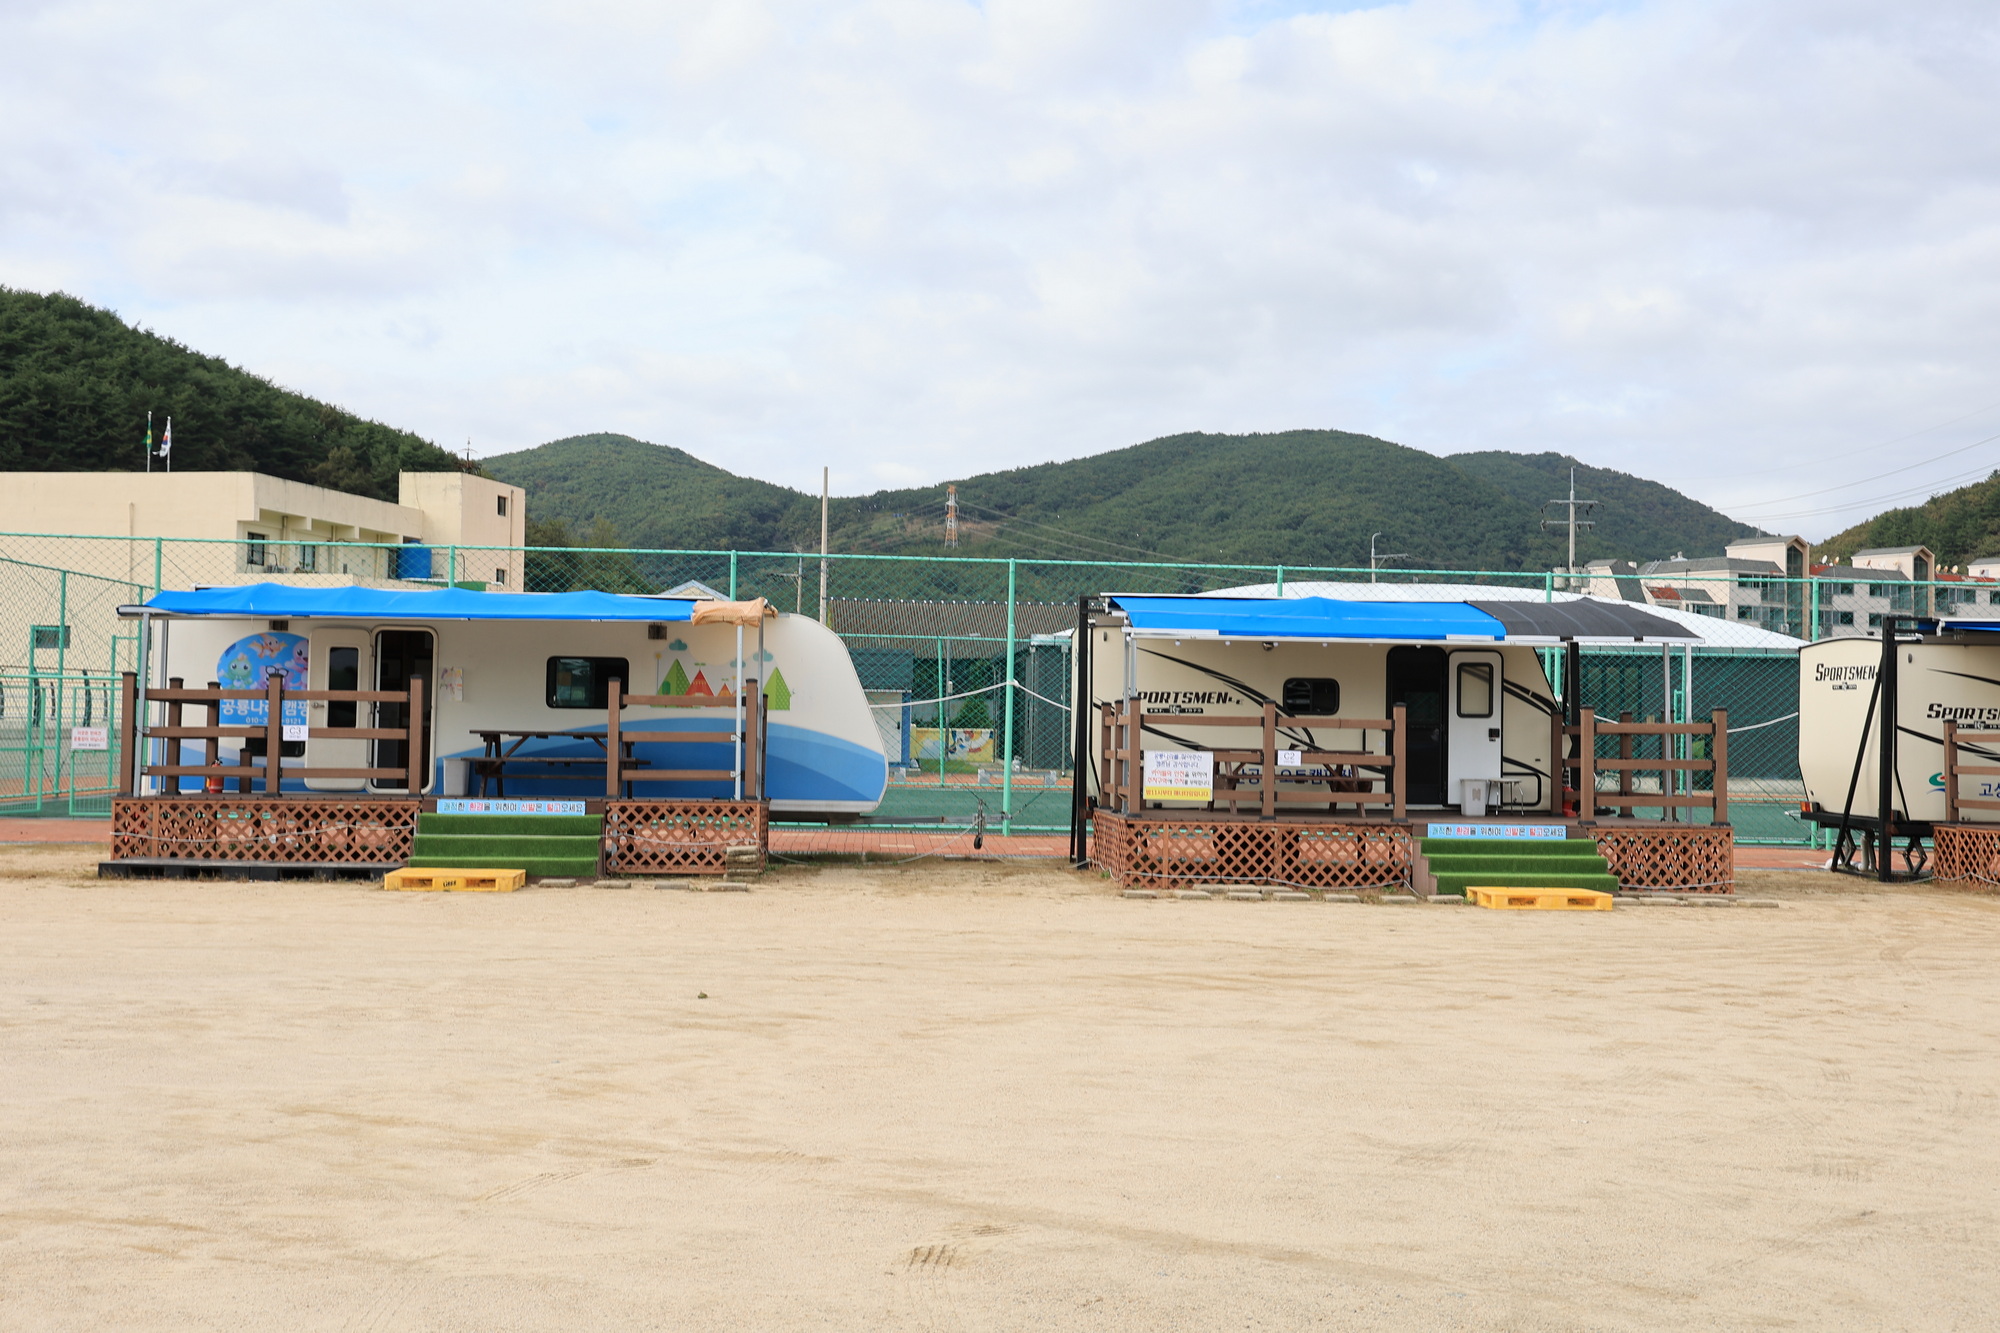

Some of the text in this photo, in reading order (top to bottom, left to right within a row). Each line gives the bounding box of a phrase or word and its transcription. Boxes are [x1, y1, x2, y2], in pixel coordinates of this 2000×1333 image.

[1815, 663, 1876, 681] SPORTSMEN
[1123, 687, 1229, 705] PORTSMEN
[1926, 703, 2000, 721] SPORTS
[289, 726, 301, 735] C3
[1283, 752, 1295, 760] C2
[469, 802, 490, 812] 환경을
[496, 802, 517, 812] 위하여
[521, 802, 542, 812] 신발은
[1456, 826, 1476, 836] 환경을
[1480, 826, 1501, 837] 위하여
[1504, 827, 1525, 837] 신발은
